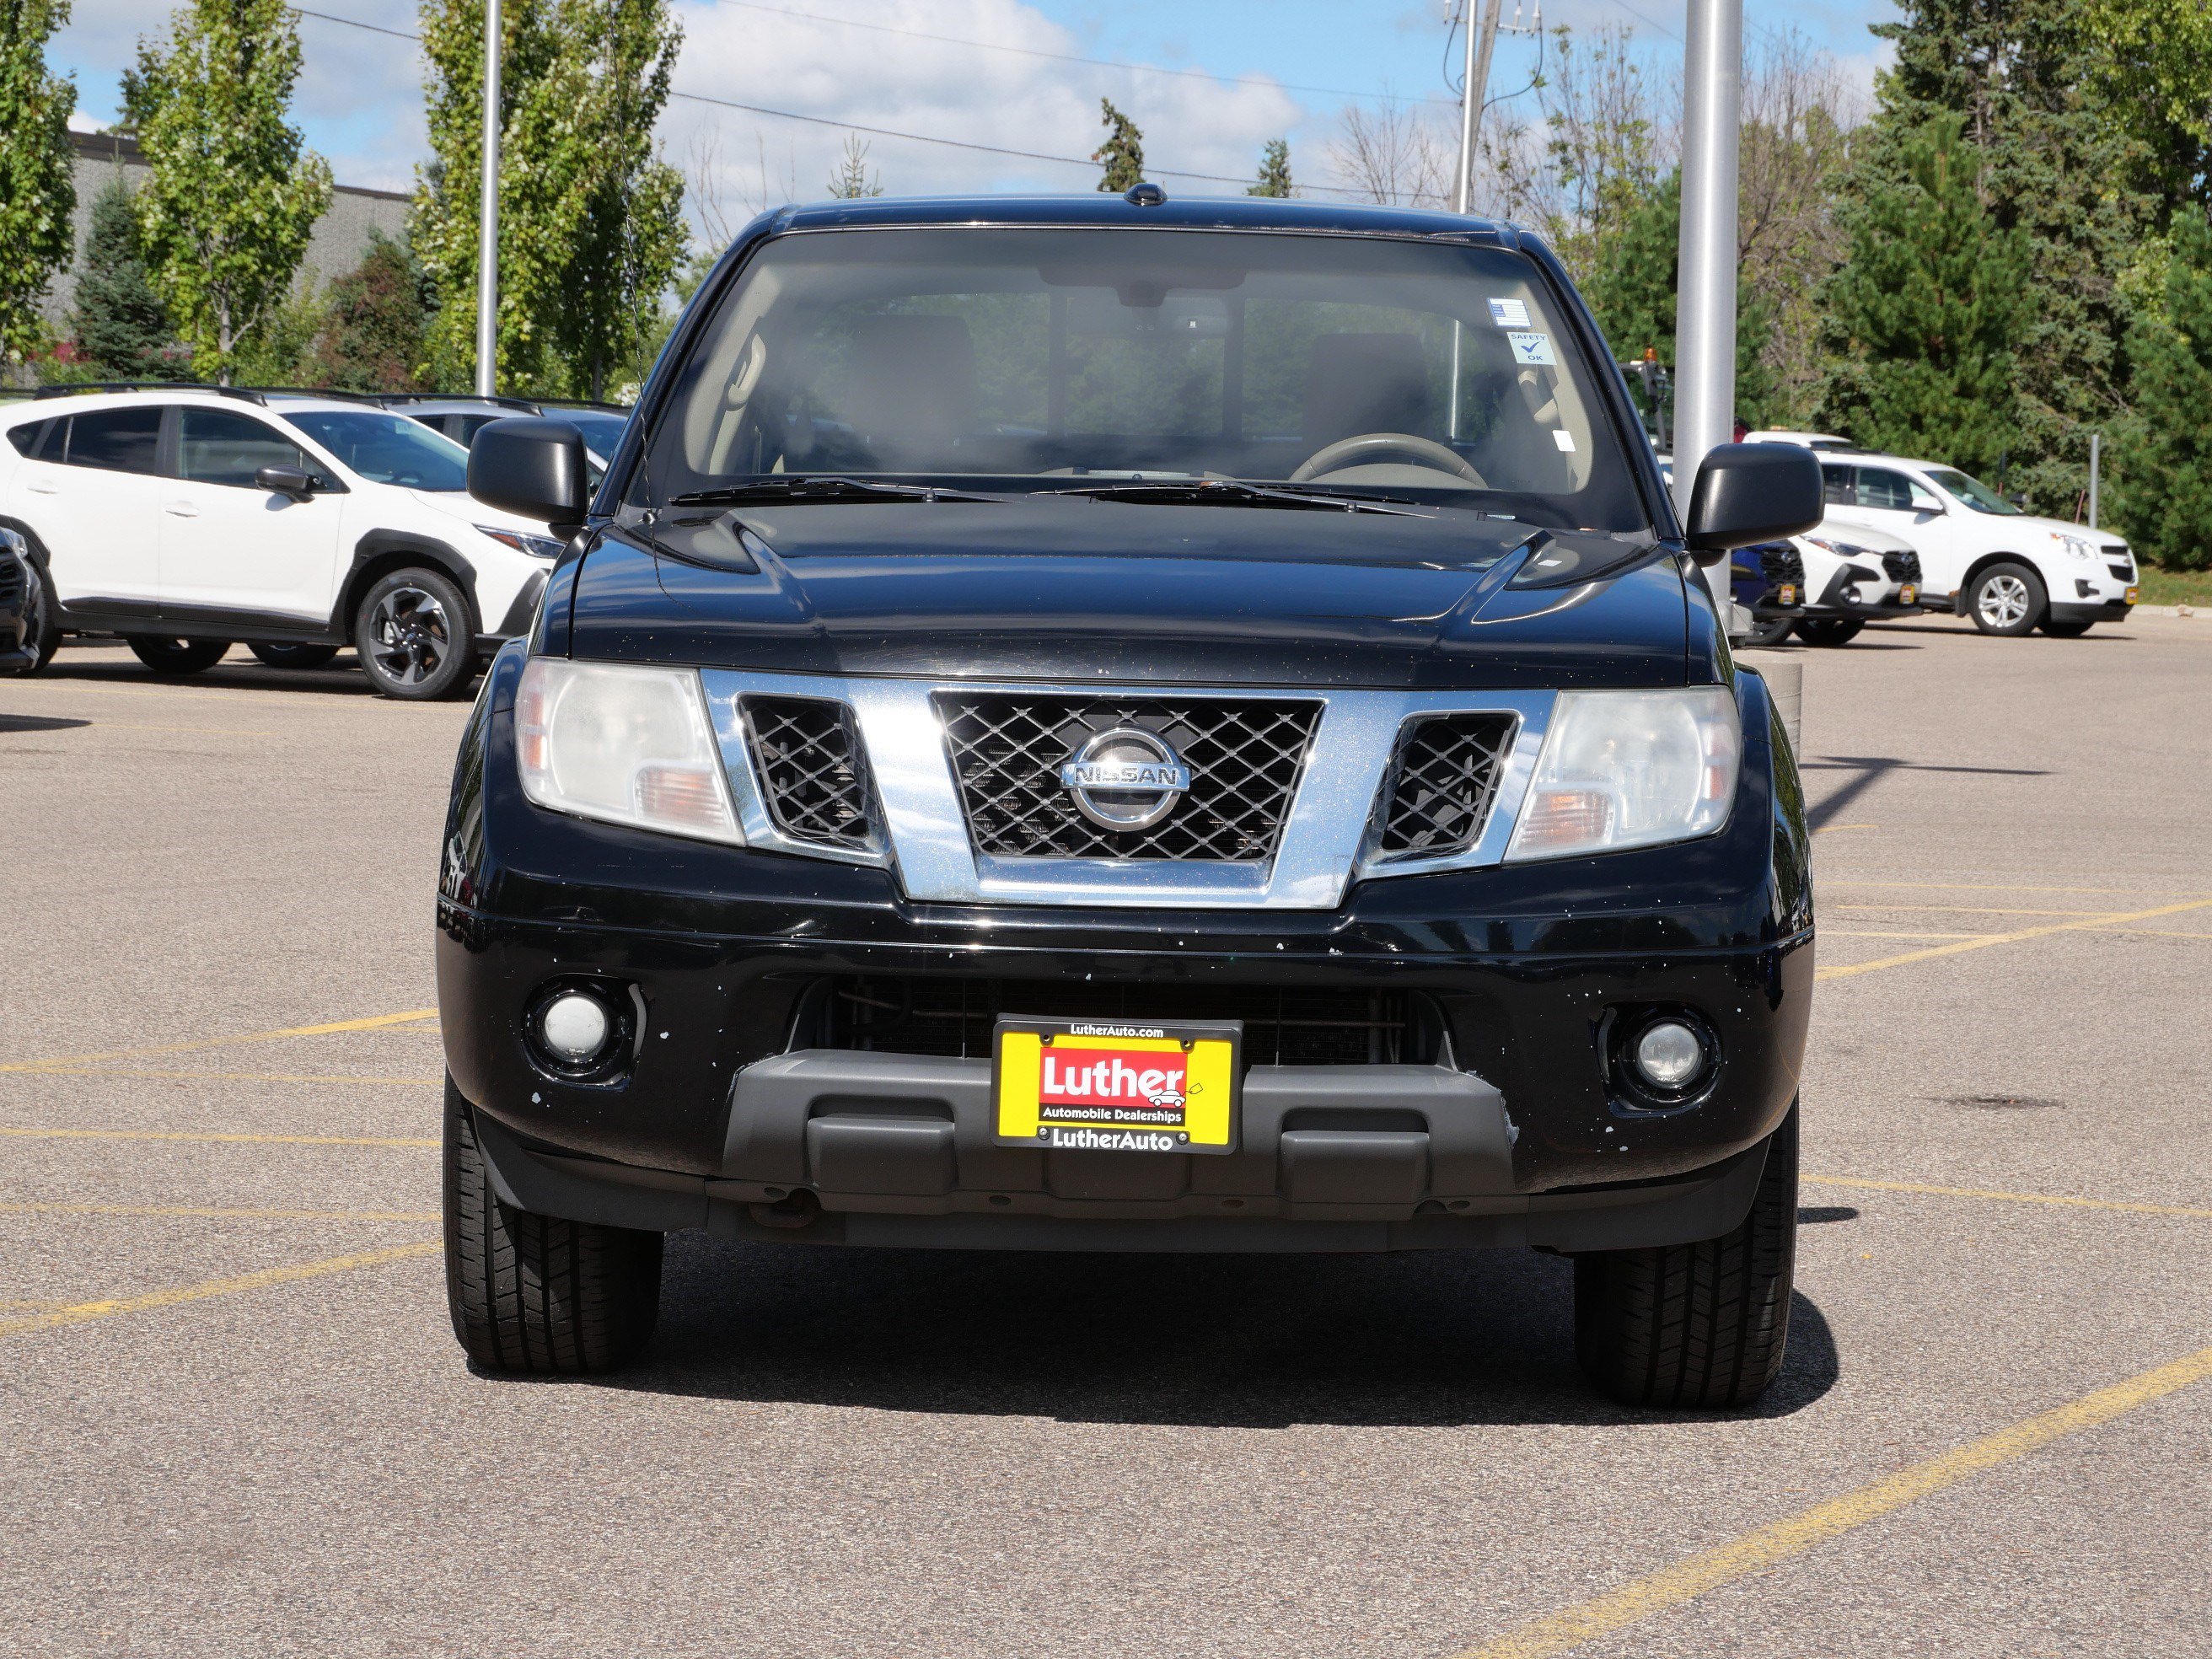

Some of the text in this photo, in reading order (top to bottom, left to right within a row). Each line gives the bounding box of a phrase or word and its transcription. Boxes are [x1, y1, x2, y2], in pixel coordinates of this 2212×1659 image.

[1074, 766, 1177, 786] NISSAN
[1070, 1023, 1164, 1039] LutherAuto.com
[1044, 1056, 1184, 1098] Luther
[1042, 1107, 1182, 1124] Automobile Dealerships
[1053, 1128, 1173, 1152] LutherAuto
